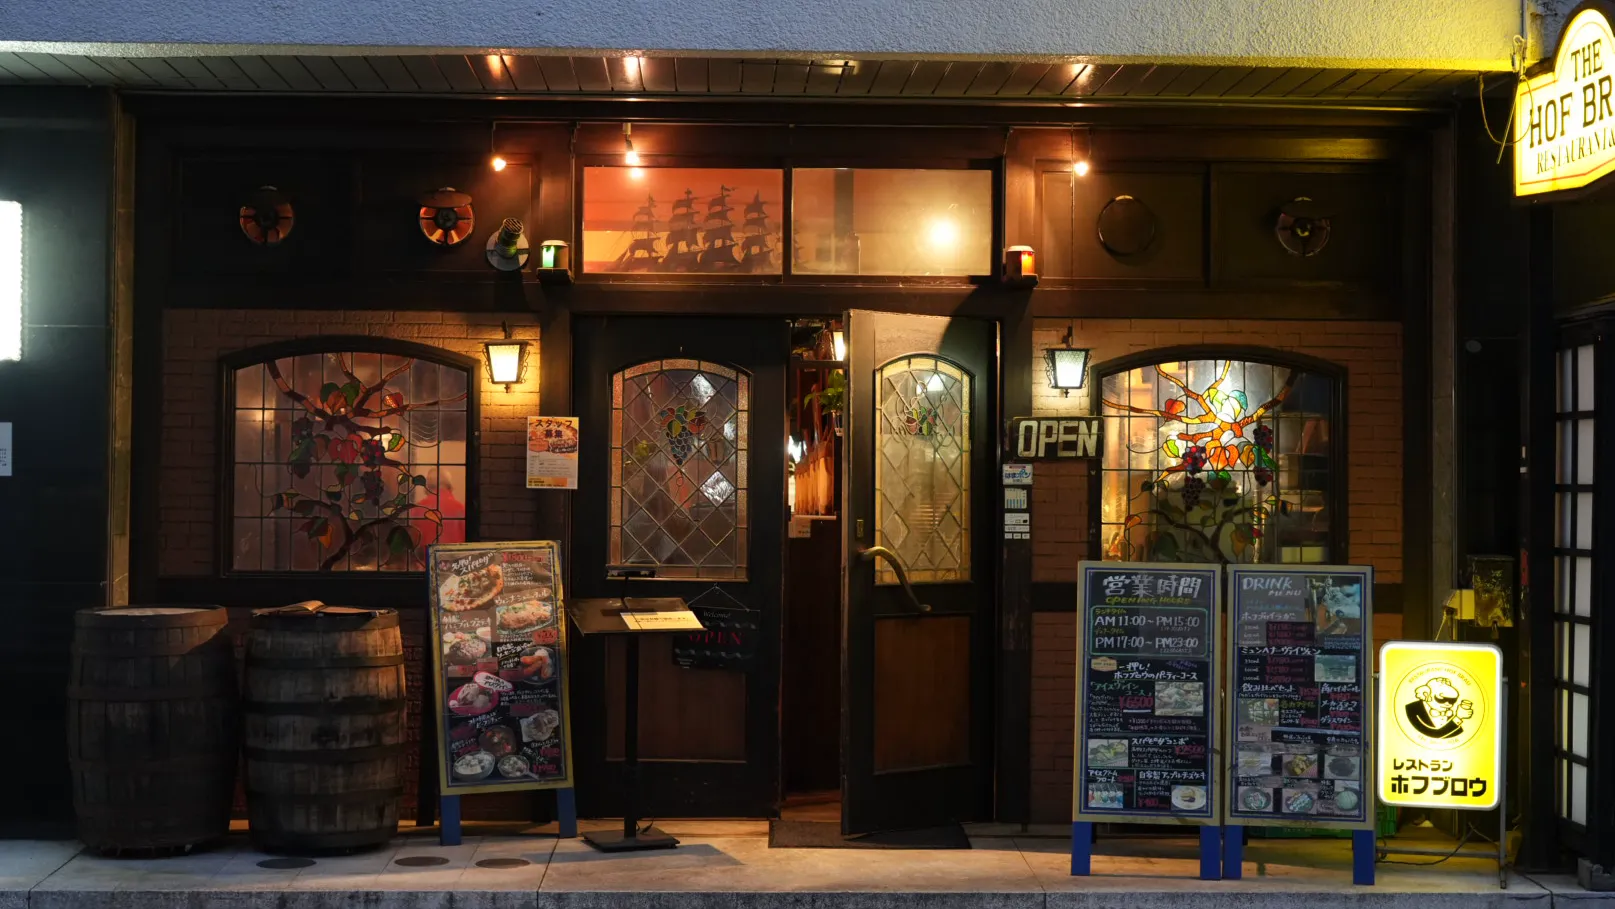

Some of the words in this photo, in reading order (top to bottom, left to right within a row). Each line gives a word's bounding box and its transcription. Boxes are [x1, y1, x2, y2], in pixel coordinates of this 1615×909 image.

[1570, 38, 1604, 83] THE
[1528, 92, 1573, 149] HOF
[1536, 126, 1607, 175] RESTAURANT
[535, 419, 573, 428] スタッフ
[1017, 420, 1099, 457] OPEN
[1102, 574, 1202, 599] 営業時間
[1243, 577, 1293, 591] DRINK
[689, 631, 743, 645] OPEN
[1393, 758, 1453, 772] レストラン
[1391, 775, 1487, 797] ホフブロウ
